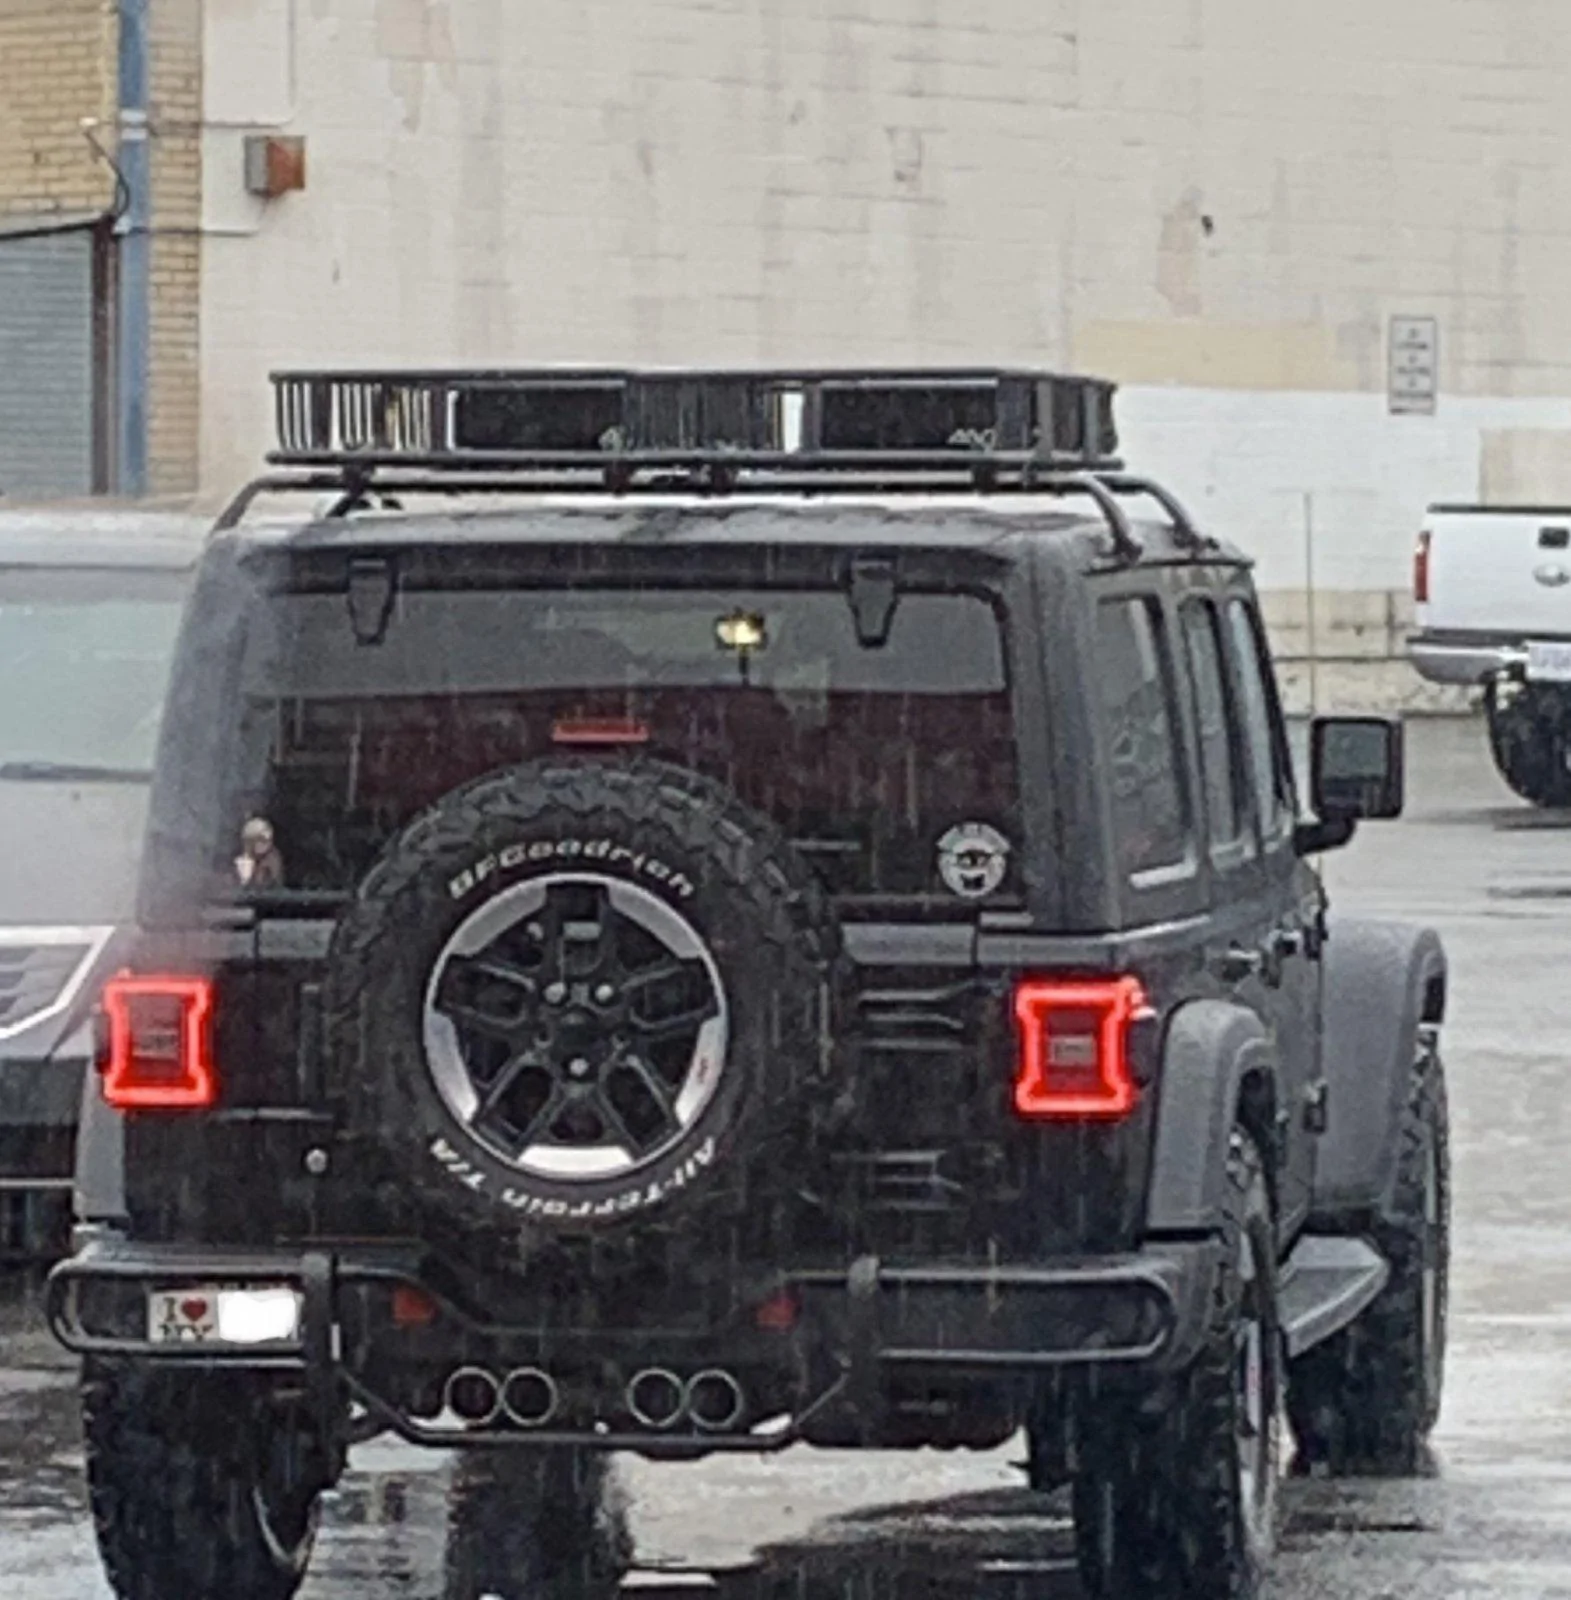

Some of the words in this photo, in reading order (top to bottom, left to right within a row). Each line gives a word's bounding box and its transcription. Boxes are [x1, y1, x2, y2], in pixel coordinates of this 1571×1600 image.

[449, 838, 694, 899] BFGoodrich
[430, 1139, 487, 1192] T/A
[502, 1137, 715, 1217] All-Terrain
[162, 1296, 177, 1323] I
